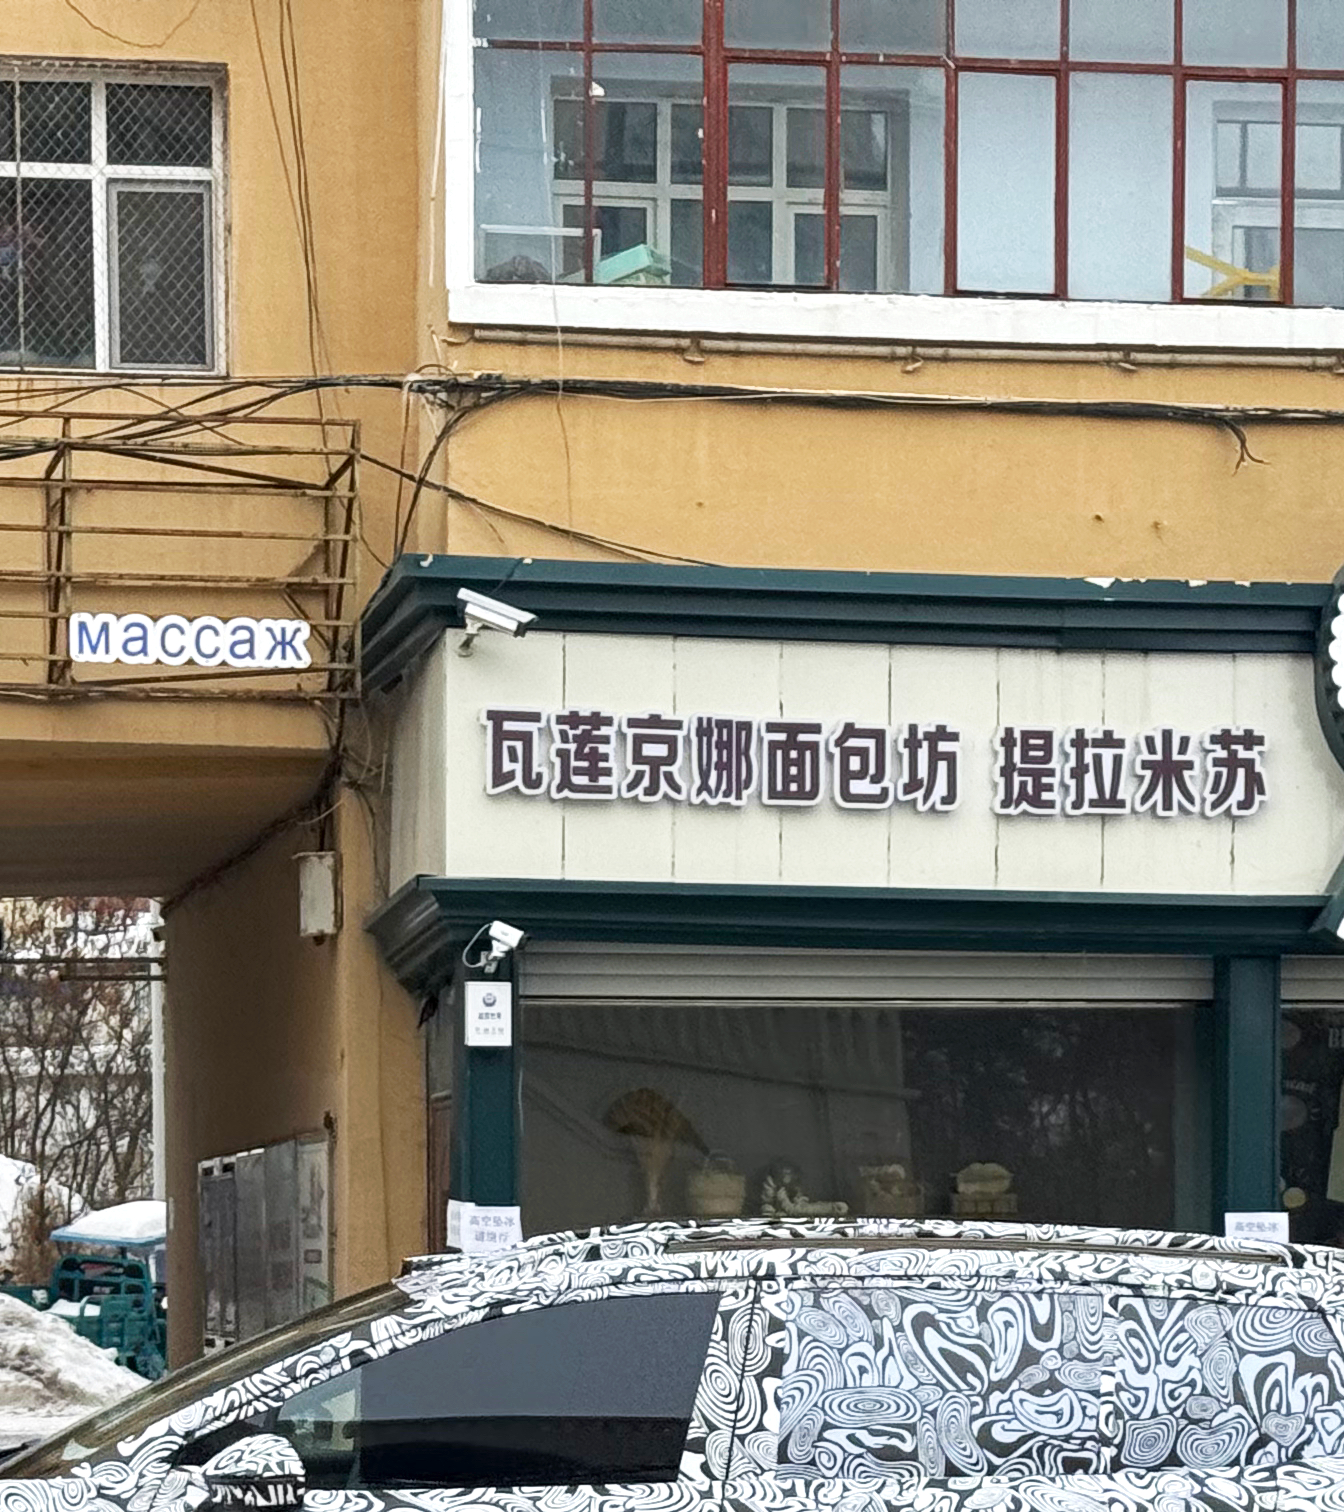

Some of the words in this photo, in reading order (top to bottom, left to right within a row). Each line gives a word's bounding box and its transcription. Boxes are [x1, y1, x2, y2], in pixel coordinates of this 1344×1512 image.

[77, 620, 303, 661] массаж
[485, 709, 962, 811] 瓦莲京娜面包坊
[998, 727, 1268, 814] 提拉米苏
